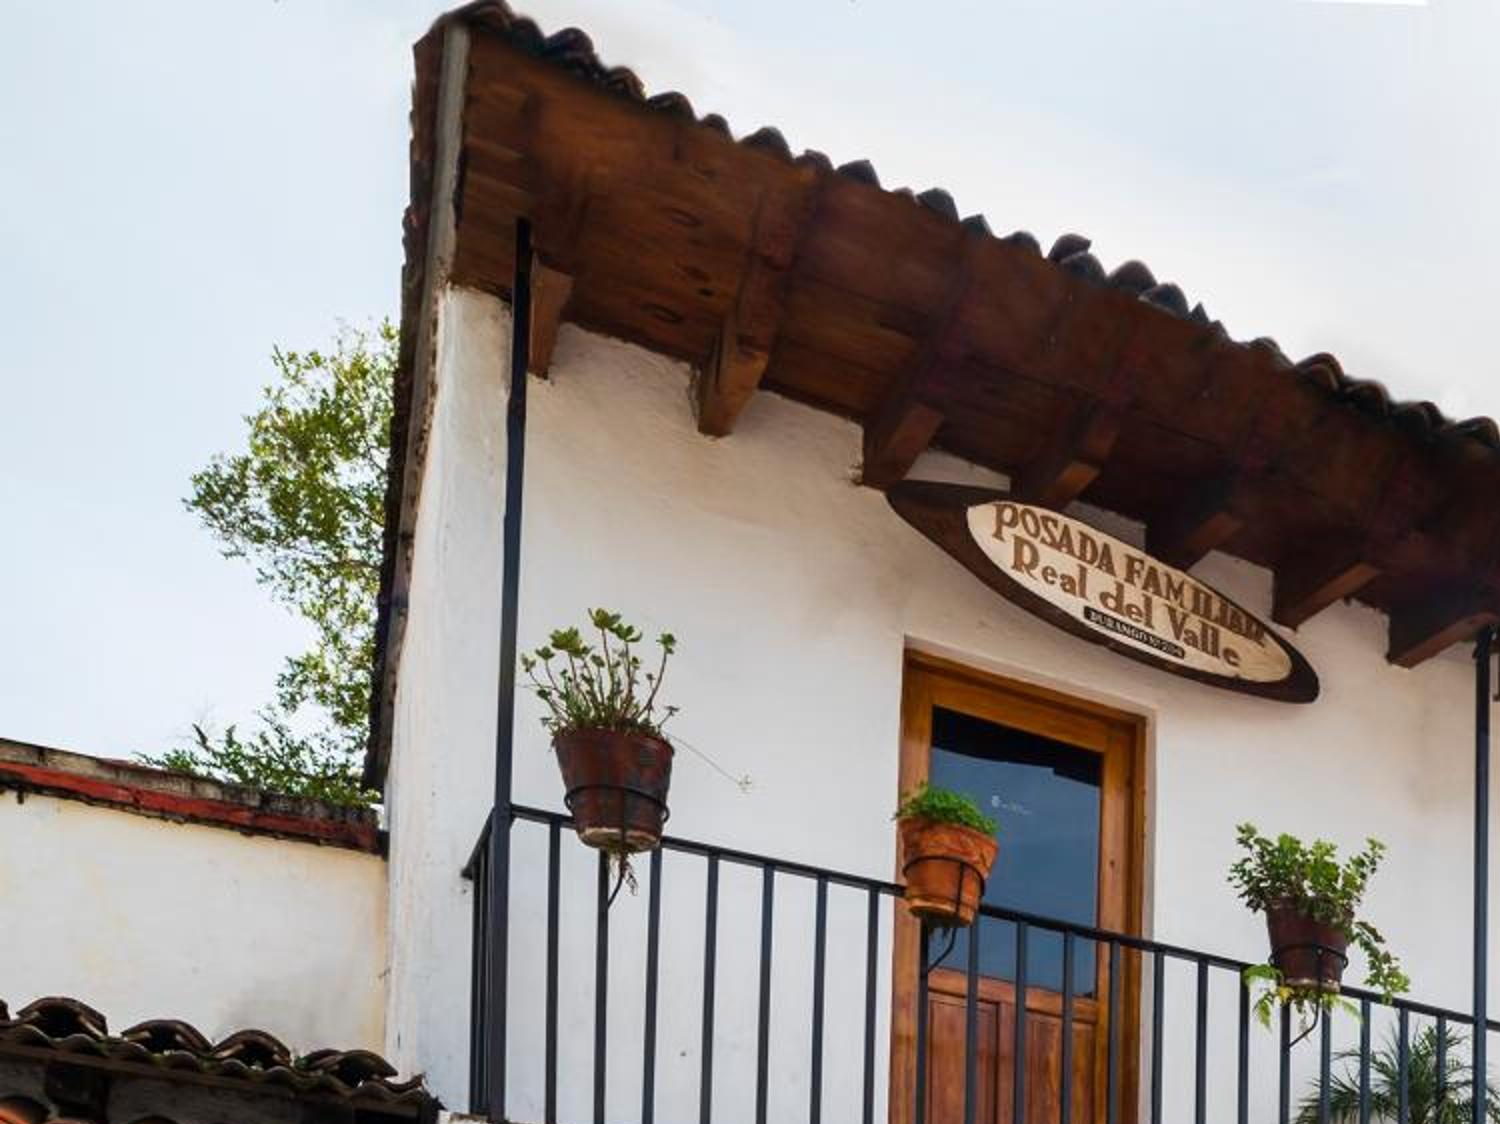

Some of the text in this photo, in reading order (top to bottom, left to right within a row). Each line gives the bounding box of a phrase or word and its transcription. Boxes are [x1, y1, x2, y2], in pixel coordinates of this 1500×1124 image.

[993, 503, 1267, 648] POSADA FAMILIAR
[1011, 536, 1241, 666] Real del Valle
